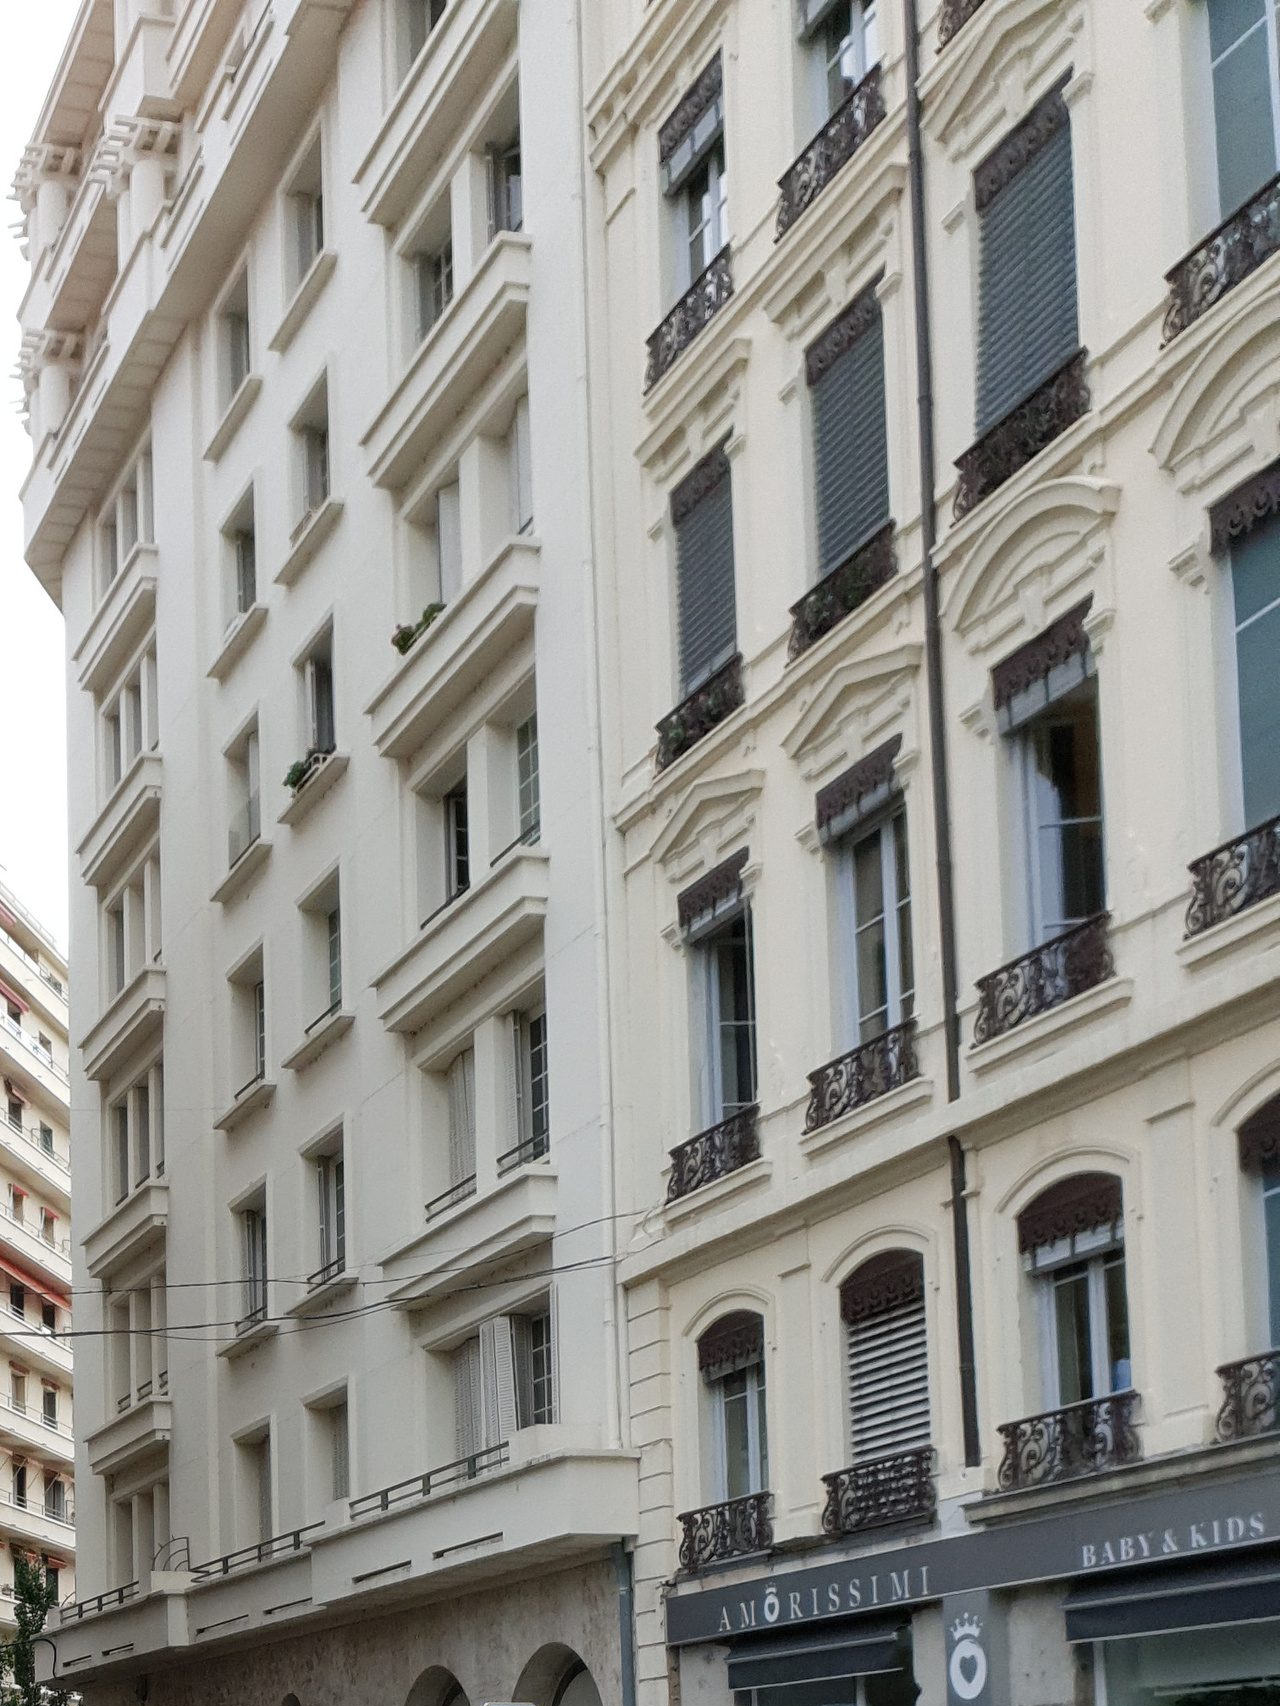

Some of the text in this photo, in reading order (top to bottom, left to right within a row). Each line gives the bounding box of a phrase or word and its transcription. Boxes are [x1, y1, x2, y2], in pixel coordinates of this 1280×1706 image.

[1082, 1511, 1266, 1568] BABY & KIDS
